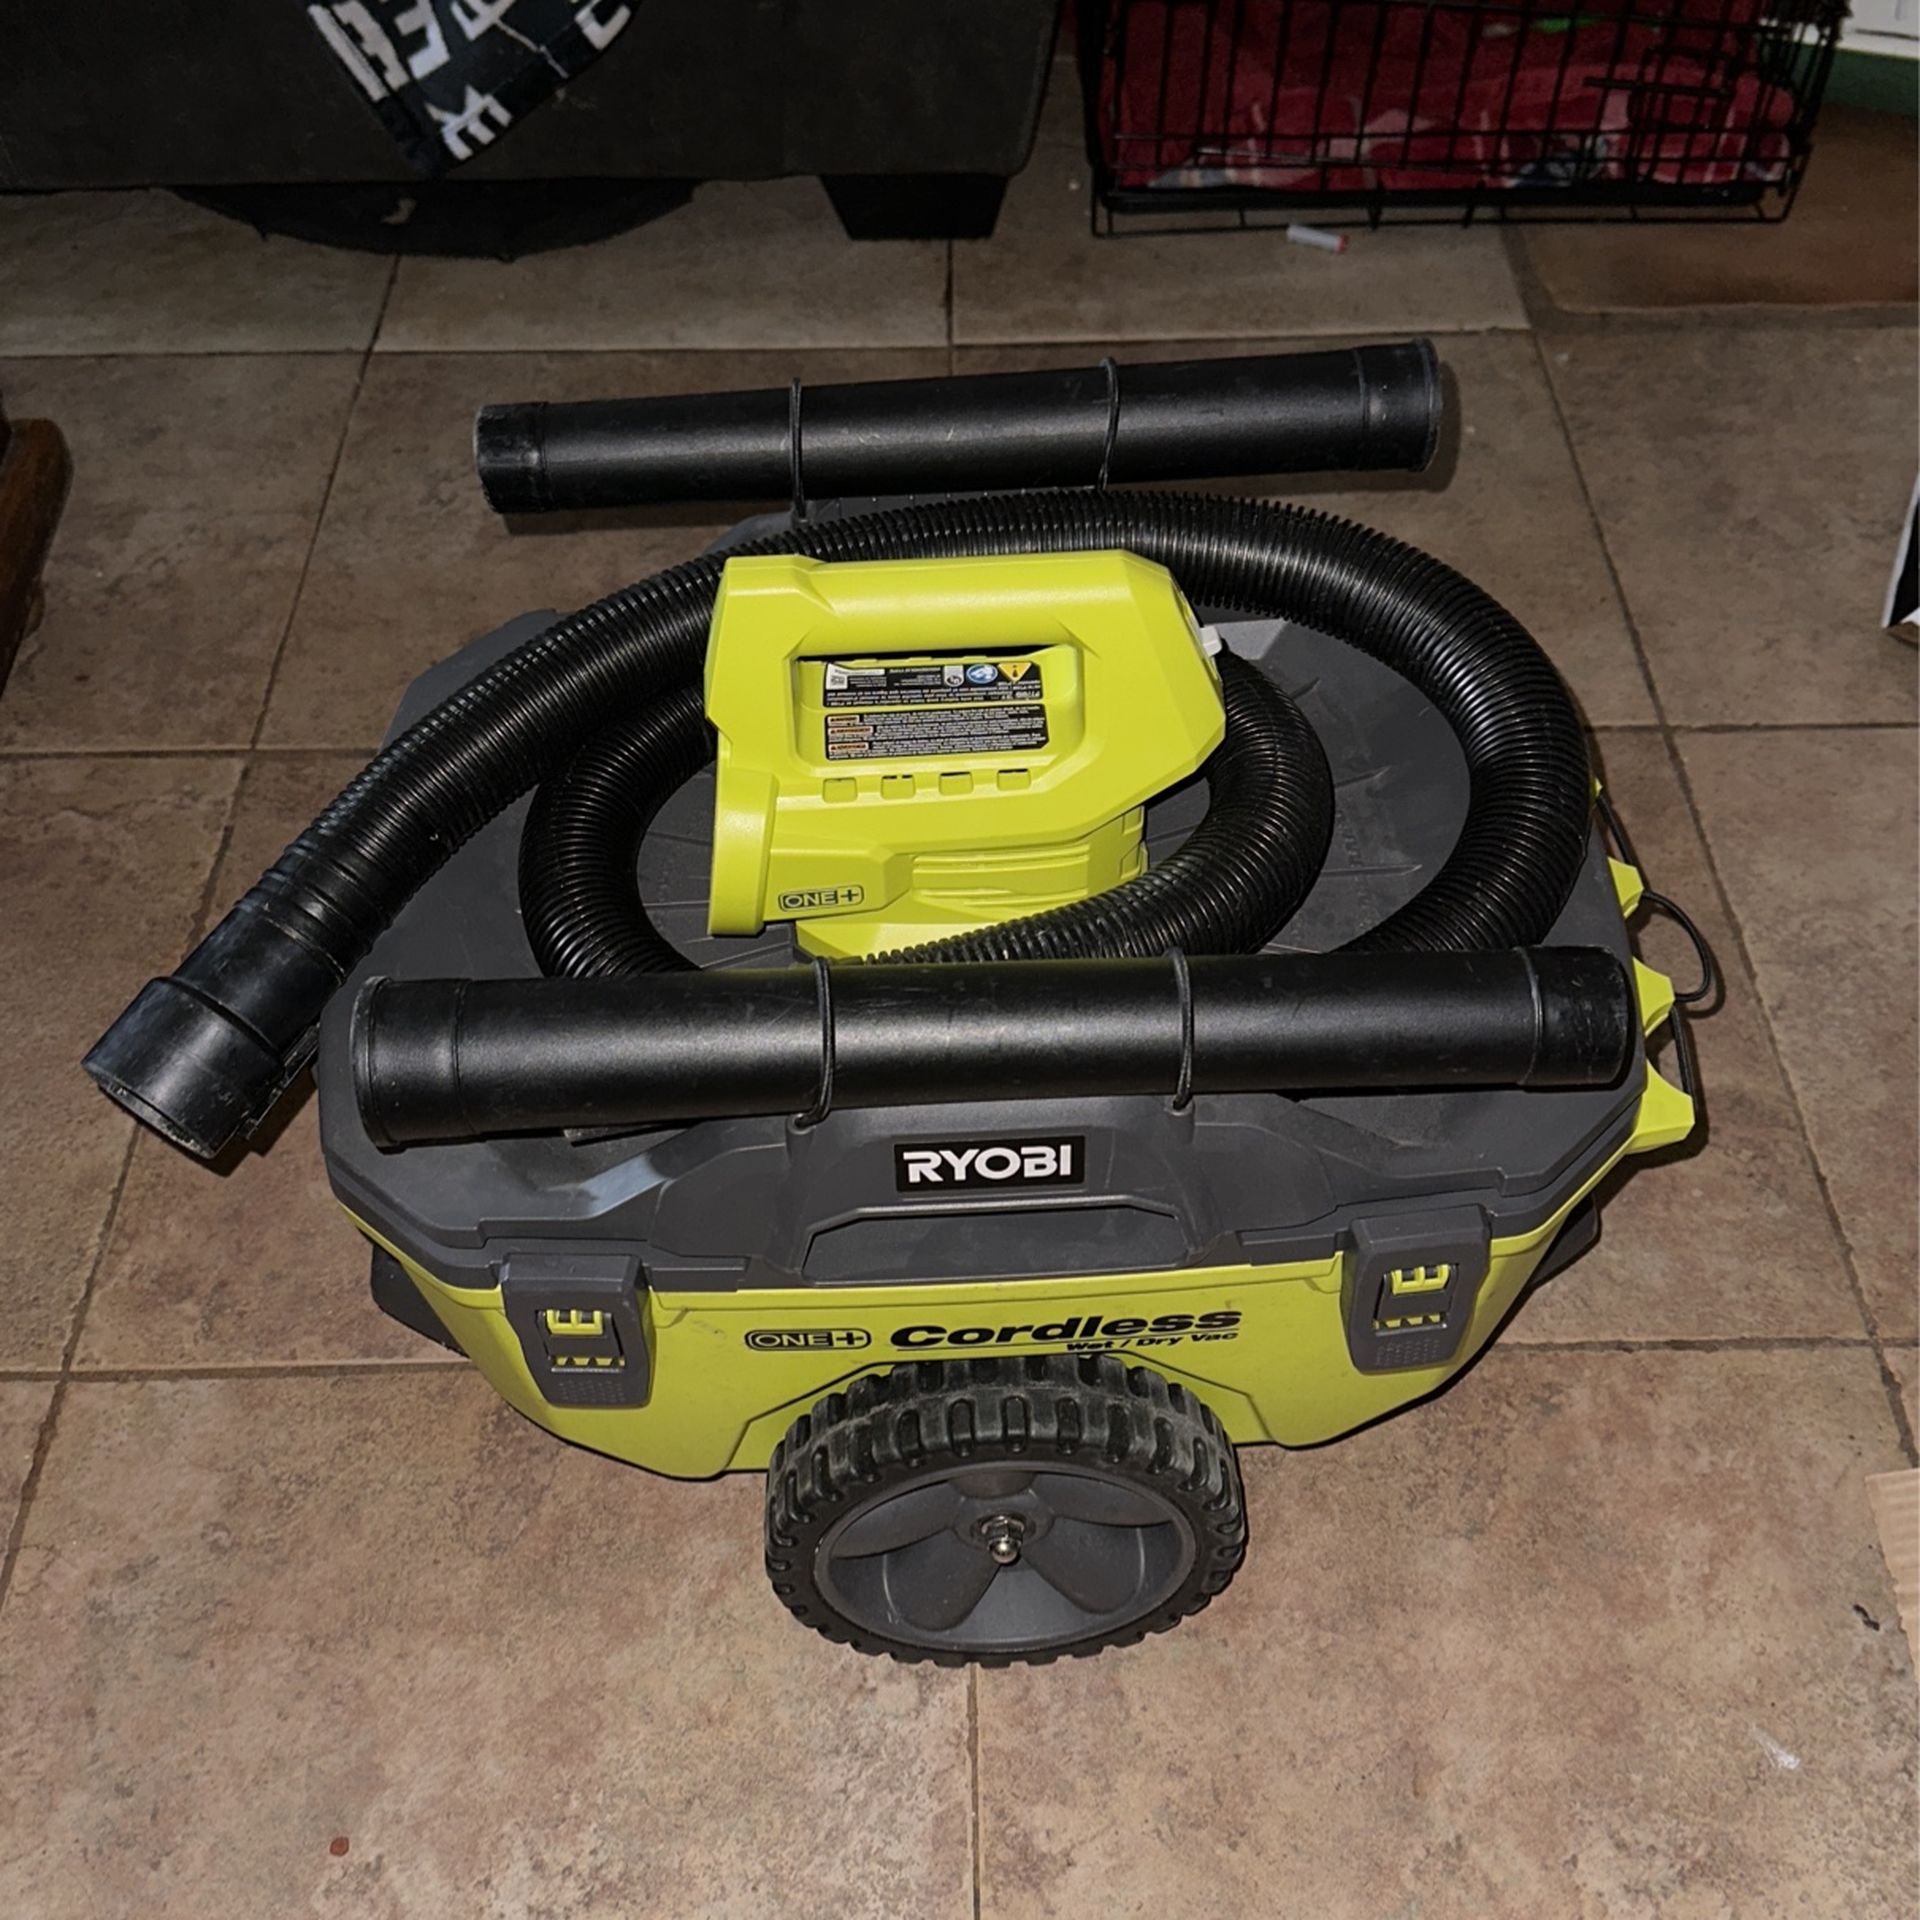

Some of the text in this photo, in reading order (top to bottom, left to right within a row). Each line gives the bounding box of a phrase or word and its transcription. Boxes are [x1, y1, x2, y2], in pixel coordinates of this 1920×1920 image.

[783, 888, 860, 908] ONE+
[903, 1144, 1072, 1183] RYOBI
[753, 1330, 866, 1348] ONE+
[890, 1311, 1242, 1348] Cordless
[1066, 1340, 1115, 1351] Wet
[1136, 1336, 1184, 1346] Dry
[1191, 1332, 1239, 1342] Vac
